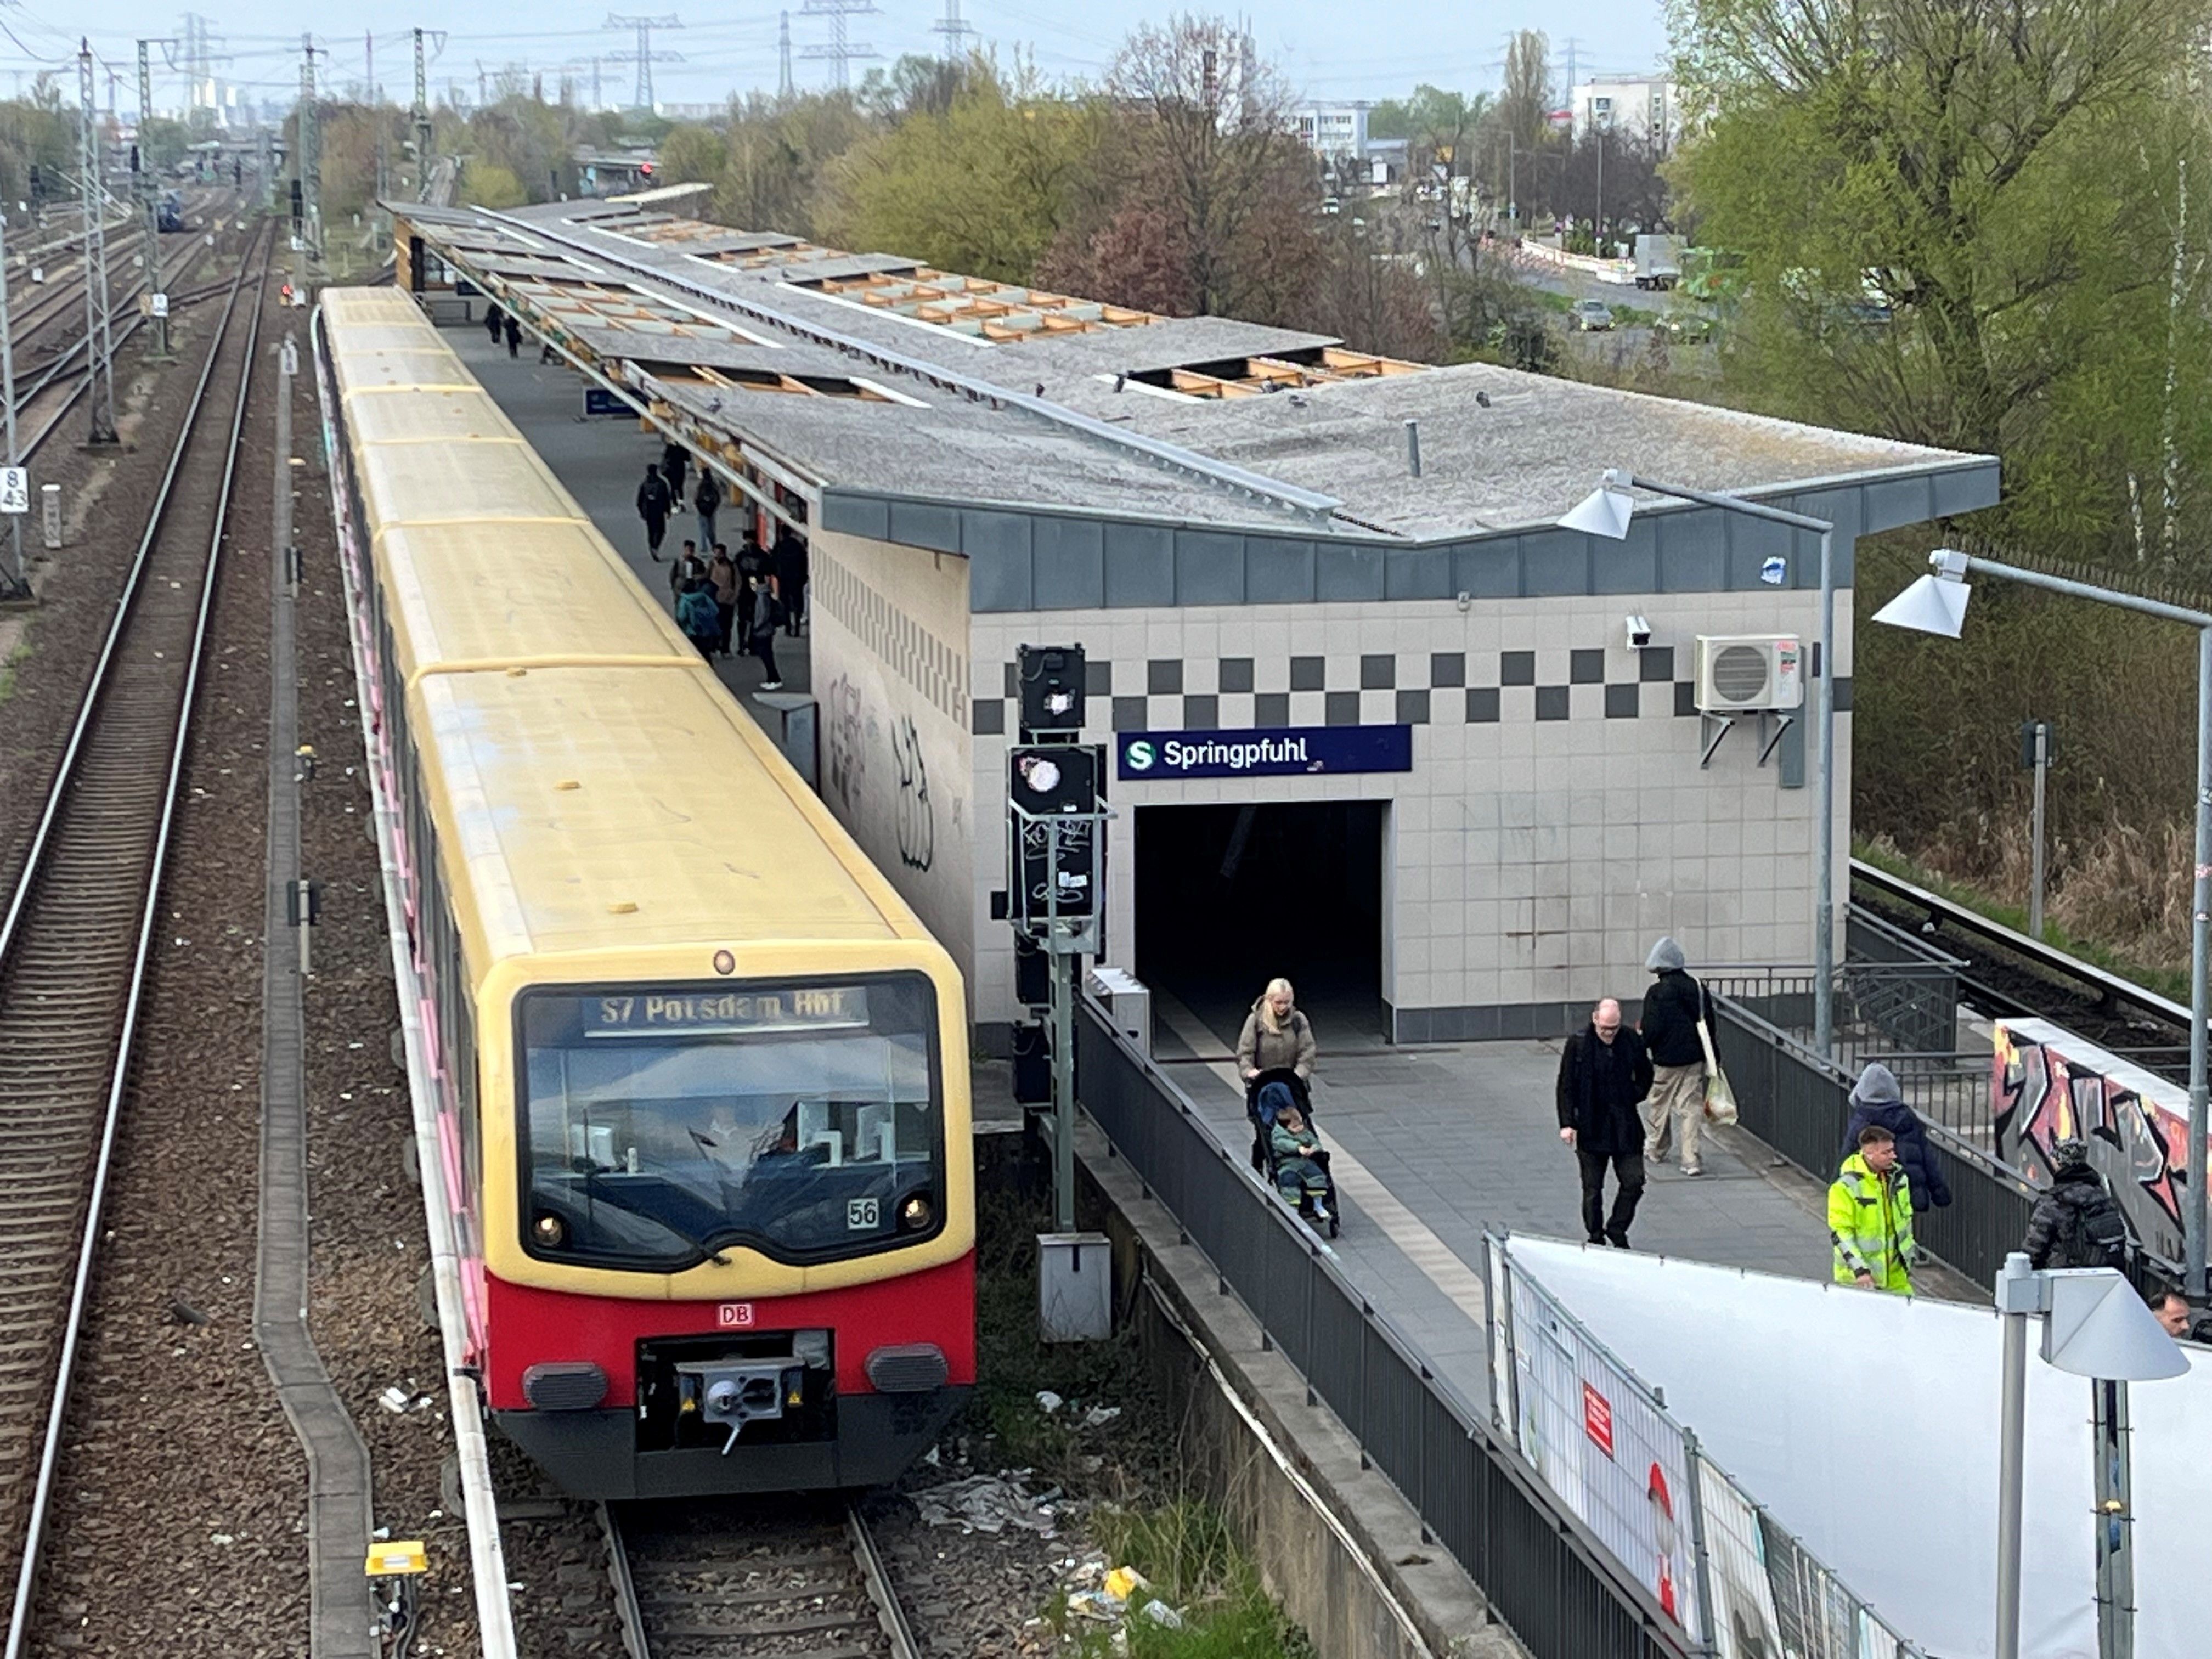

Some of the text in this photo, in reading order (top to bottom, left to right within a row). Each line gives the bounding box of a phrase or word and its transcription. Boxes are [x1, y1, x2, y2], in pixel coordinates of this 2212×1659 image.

[7, 470, 19, 487] 8
[3, 489, 26, 507] 43
[1130, 737, 1308, 770] S Springpfuhl
[601, 997, 634, 1023] S7
[646, 994, 782, 1023] Potsdam
[850, 1201, 876, 1225] 56
[723, 1306, 748, 1323] DB
